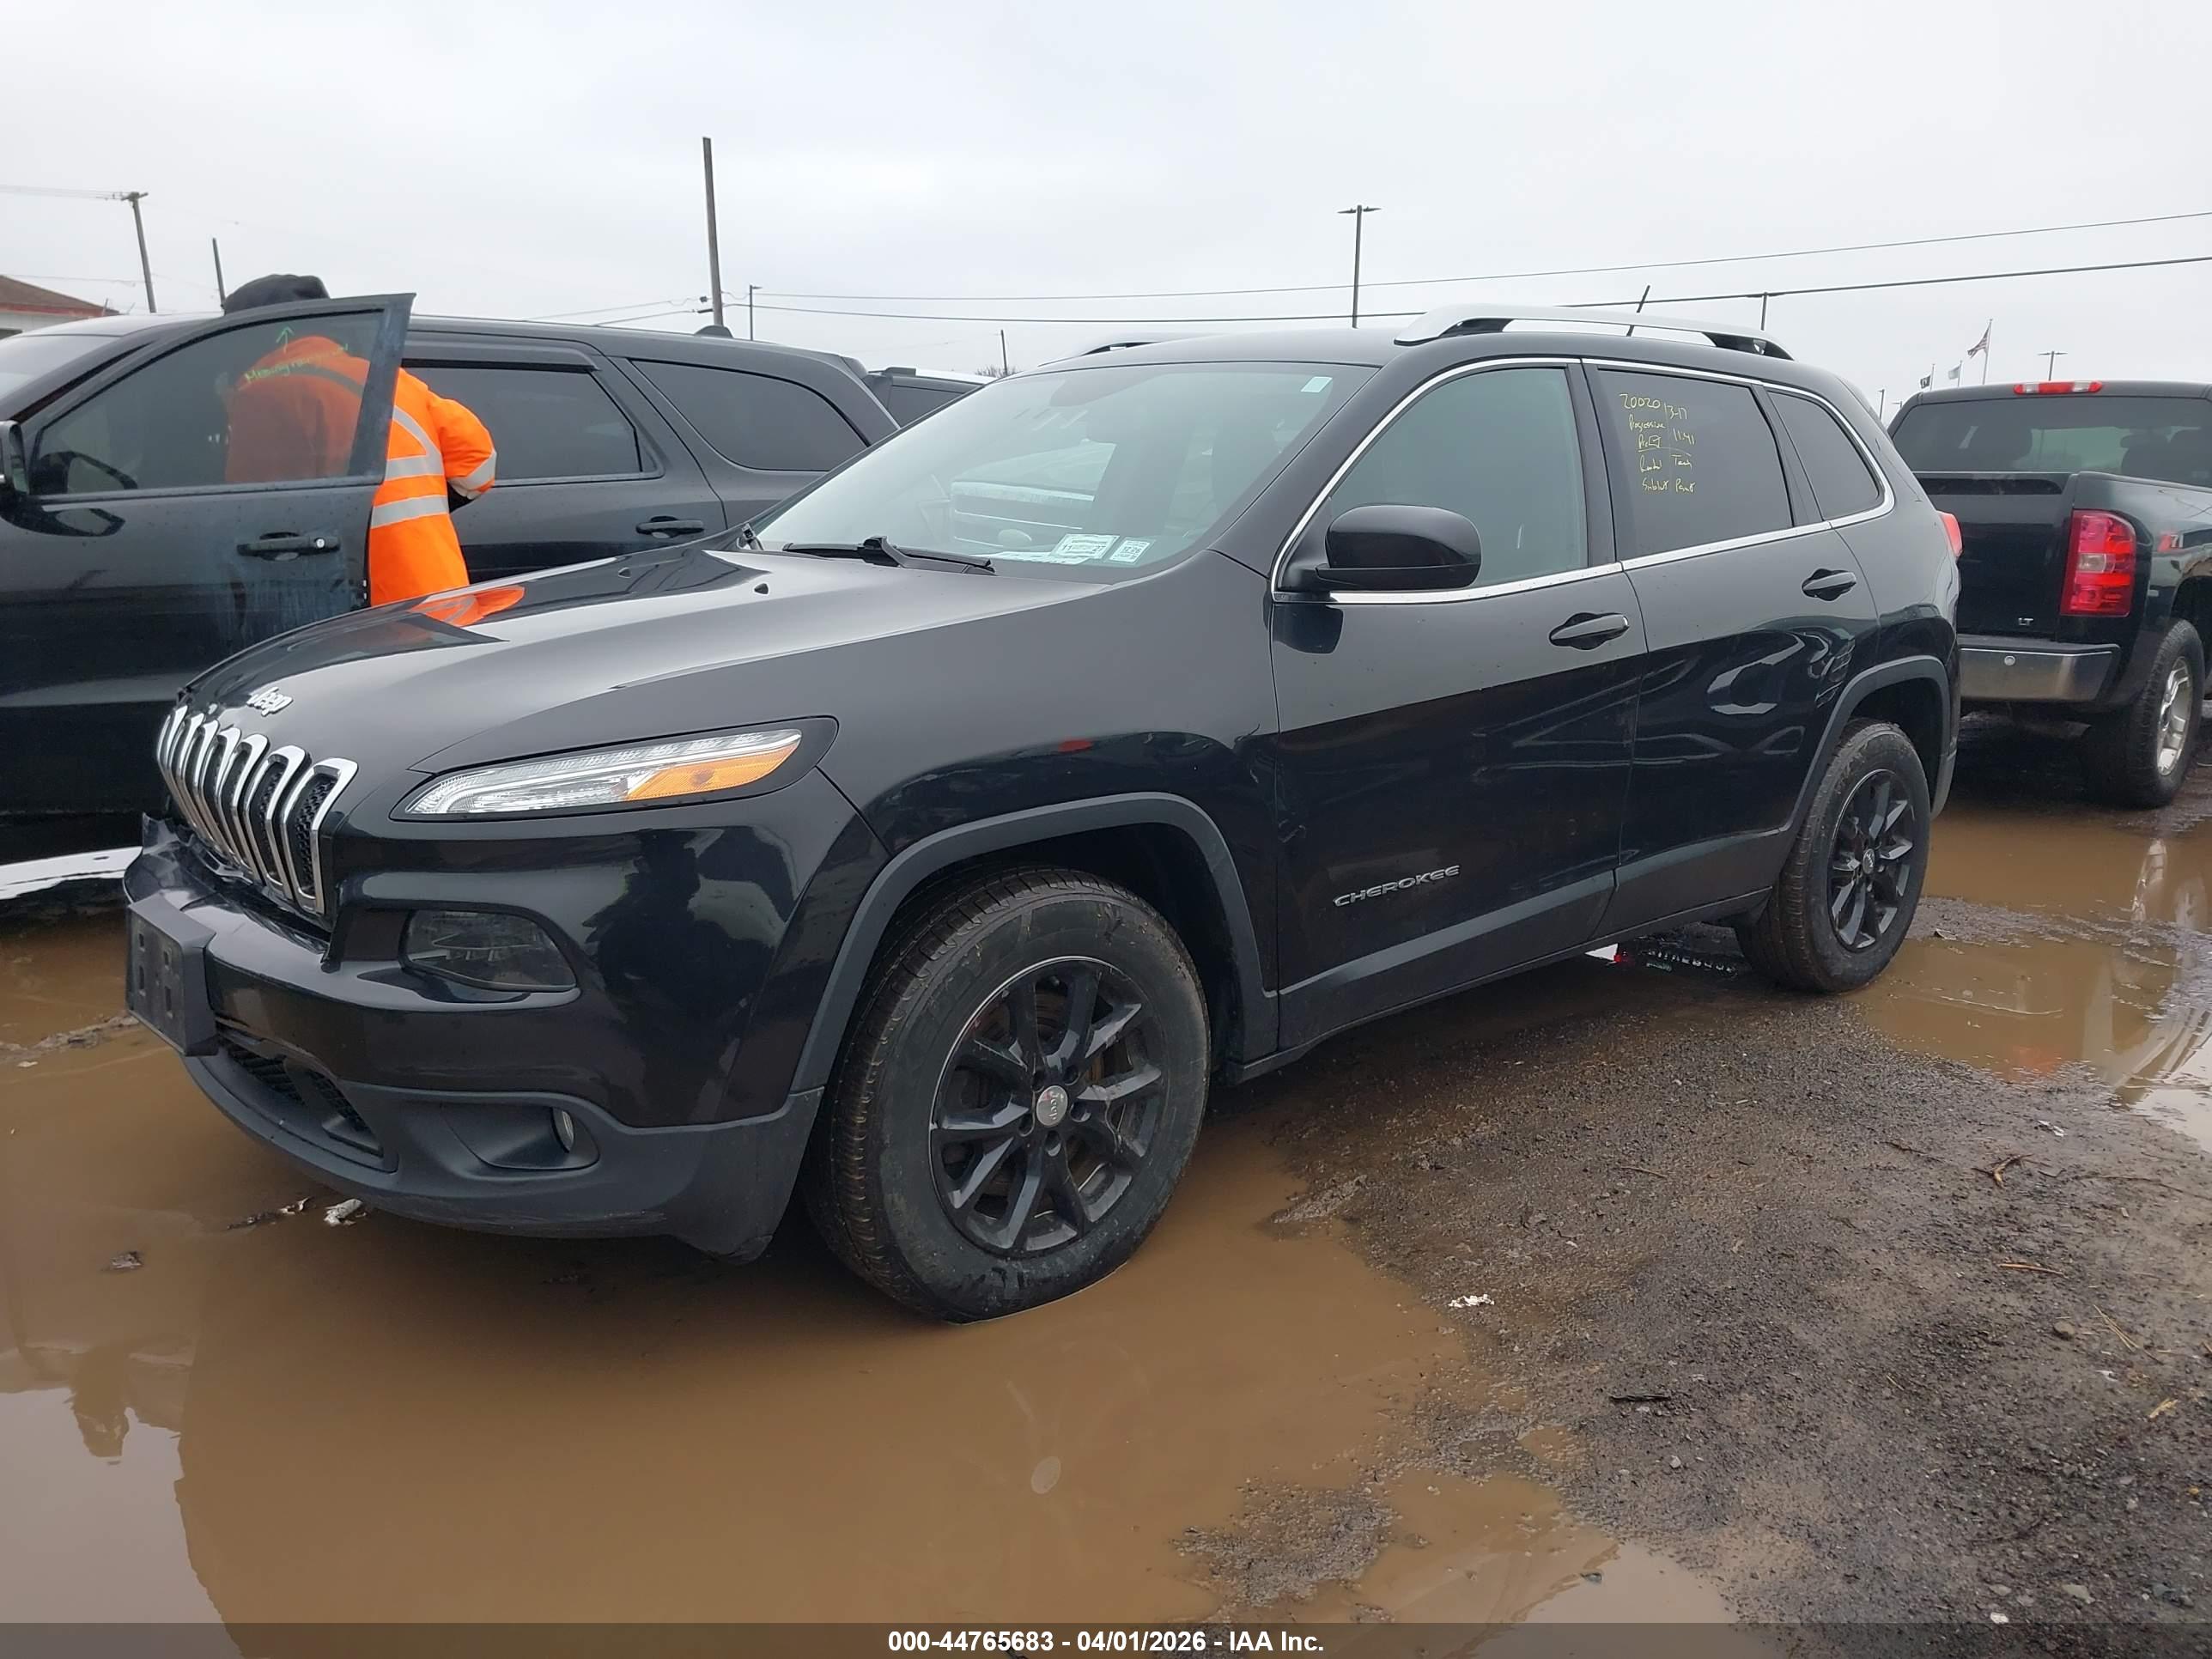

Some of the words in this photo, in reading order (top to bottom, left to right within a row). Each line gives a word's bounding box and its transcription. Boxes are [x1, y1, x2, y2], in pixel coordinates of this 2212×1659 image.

[2018, 617, 2034, 626] LT
[246, 686, 294, 717] Jeep
[1333, 865, 1460, 907] CHEROKEE
[1048, 1091, 1060, 1121] Jeep
